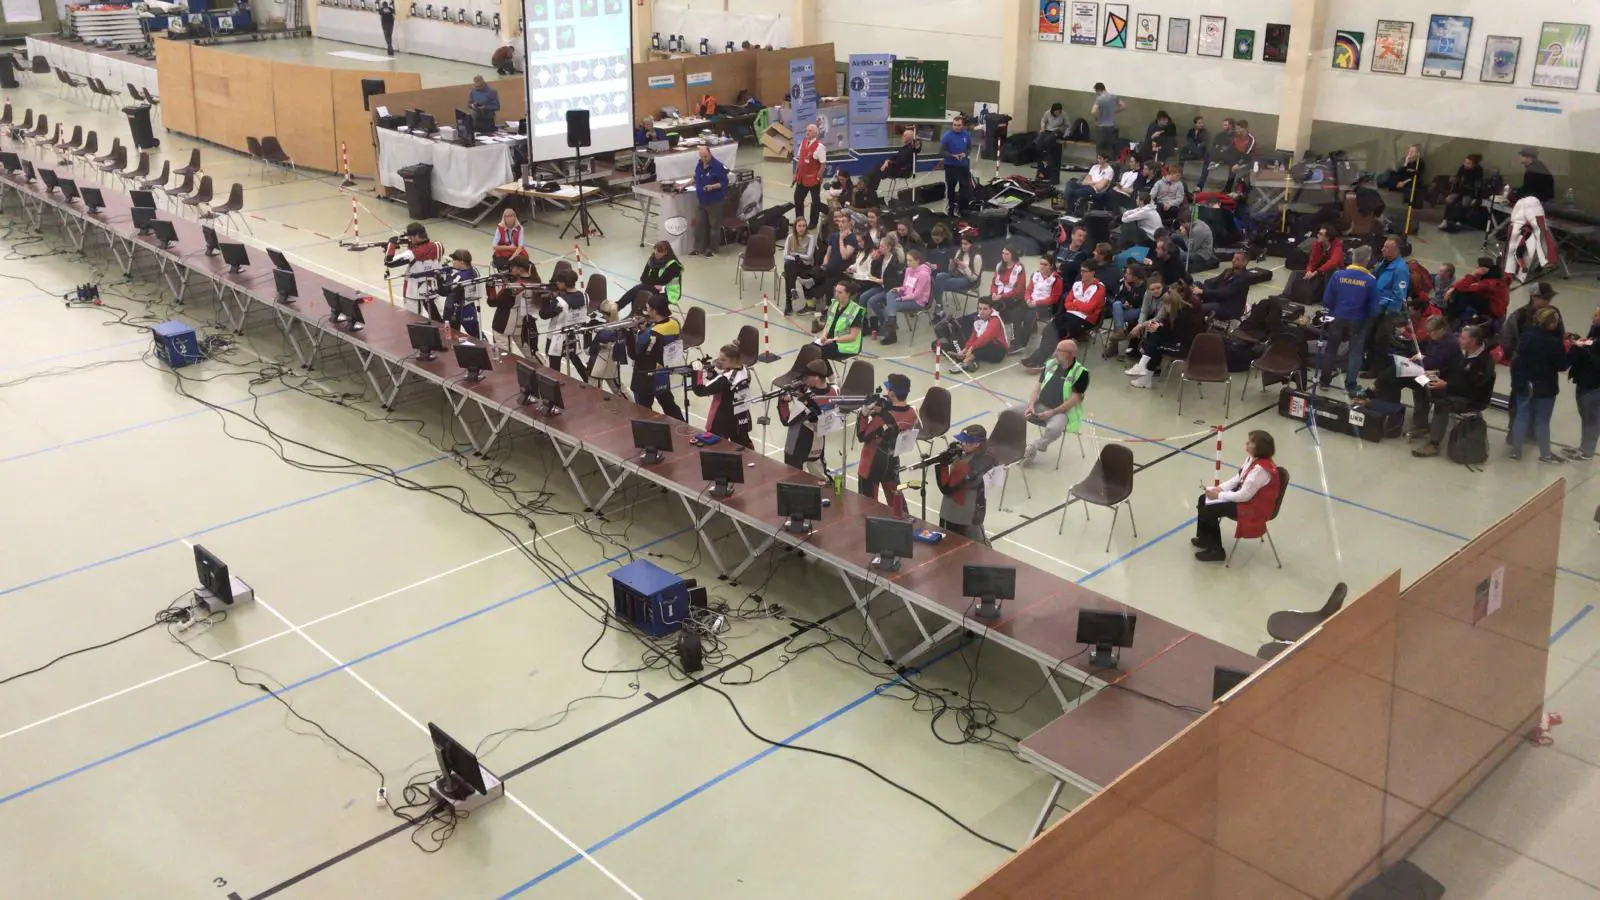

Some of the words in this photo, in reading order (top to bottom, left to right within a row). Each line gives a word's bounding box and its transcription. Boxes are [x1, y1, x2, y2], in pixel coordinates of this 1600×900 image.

[1339, 277, 1367, 287] UKRAINE
[180, 344, 187, 353] 2
[1350, 414, 1363, 423] UKR
[213, 877, 228, 888] 3
